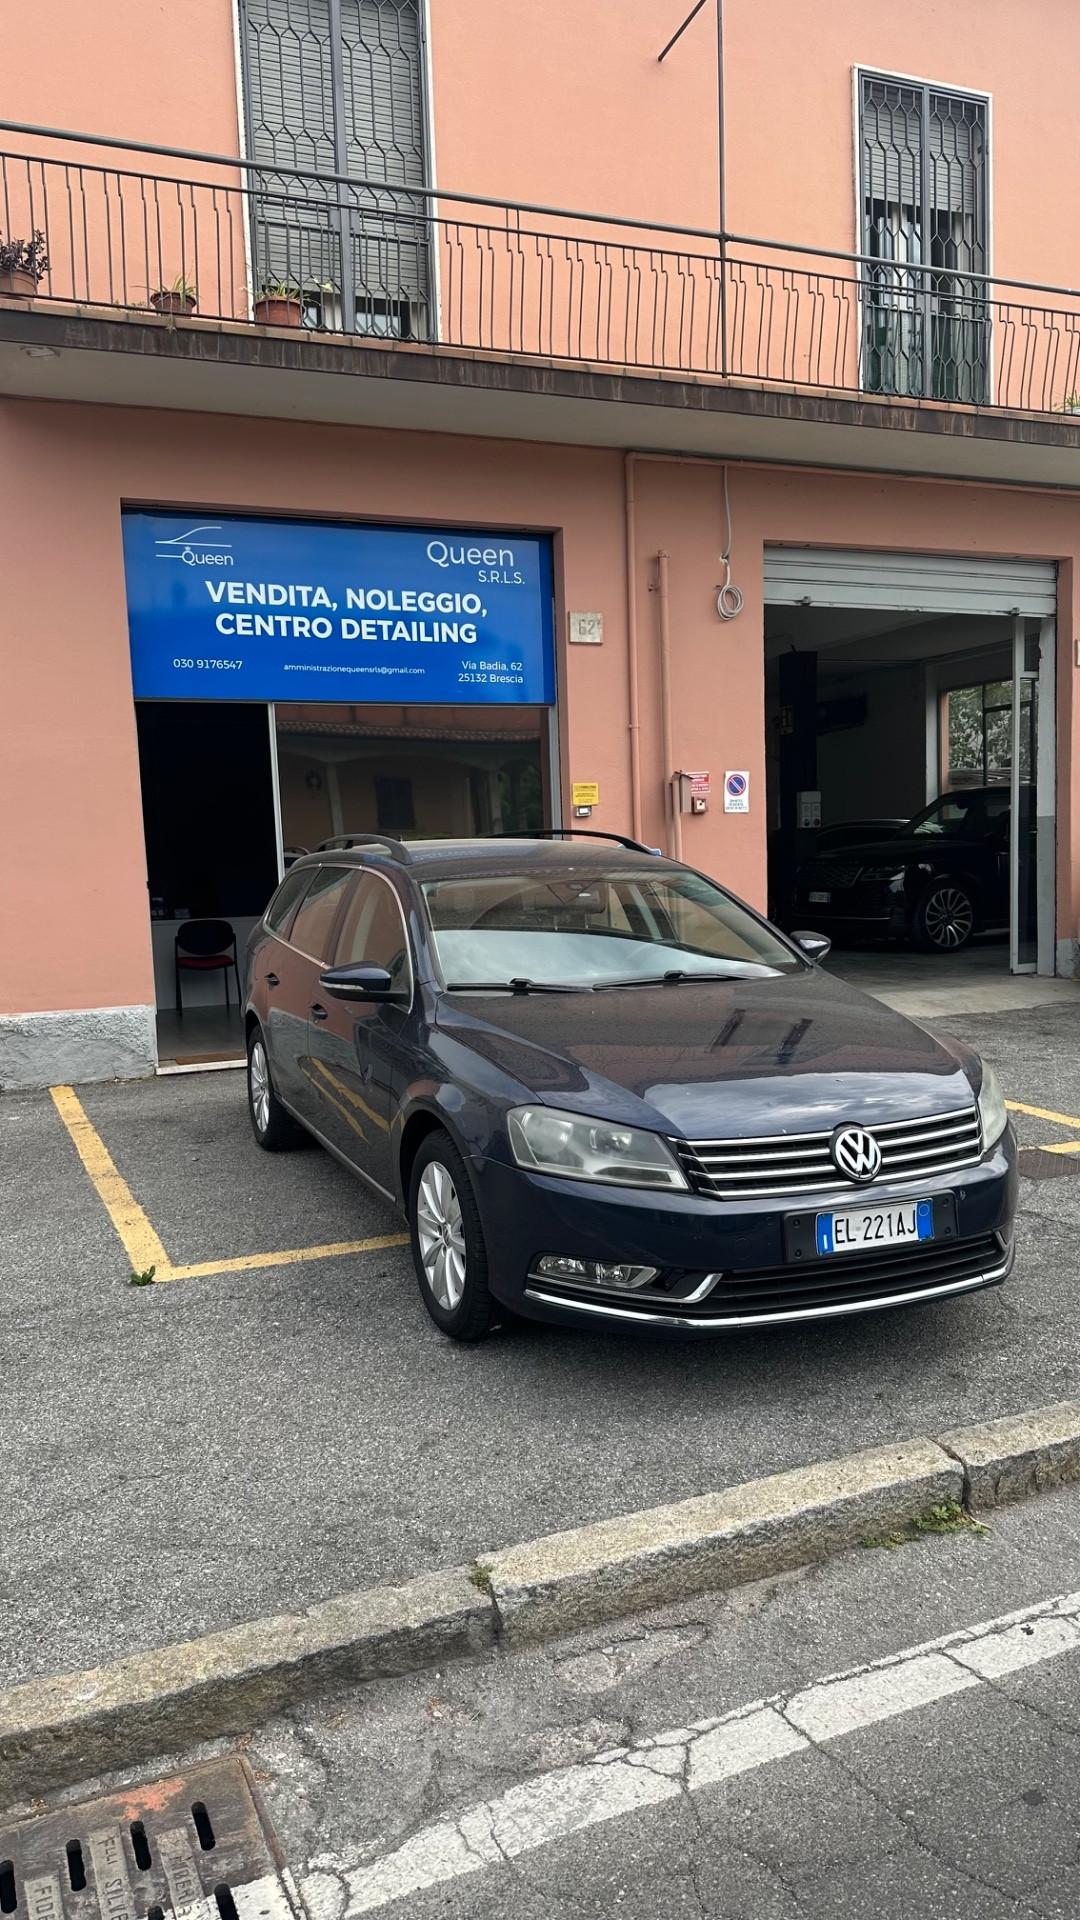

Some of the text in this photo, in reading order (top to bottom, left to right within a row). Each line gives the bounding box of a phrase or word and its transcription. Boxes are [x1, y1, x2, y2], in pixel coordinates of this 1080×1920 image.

[181, 550, 235, 567] Queen
[426, 540, 514, 568] Queen
[478, 569, 526, 585] S.R.L.S.
[204, 580, 488, 618] VENDITA, NOLEGGIO,
[215, 612, 478, 644] CENTRO DETAILING
[173, 658, 243, 670] 030 9176547
[283, 663, 426, 675] amministrazionequeensrls@gmail.com
[461, 660, 524, 672] Via Badia, 62
[458, 673, 525, 684] 25132 Brescia
[834, 1209, 917, 1244] EL 221AJ
